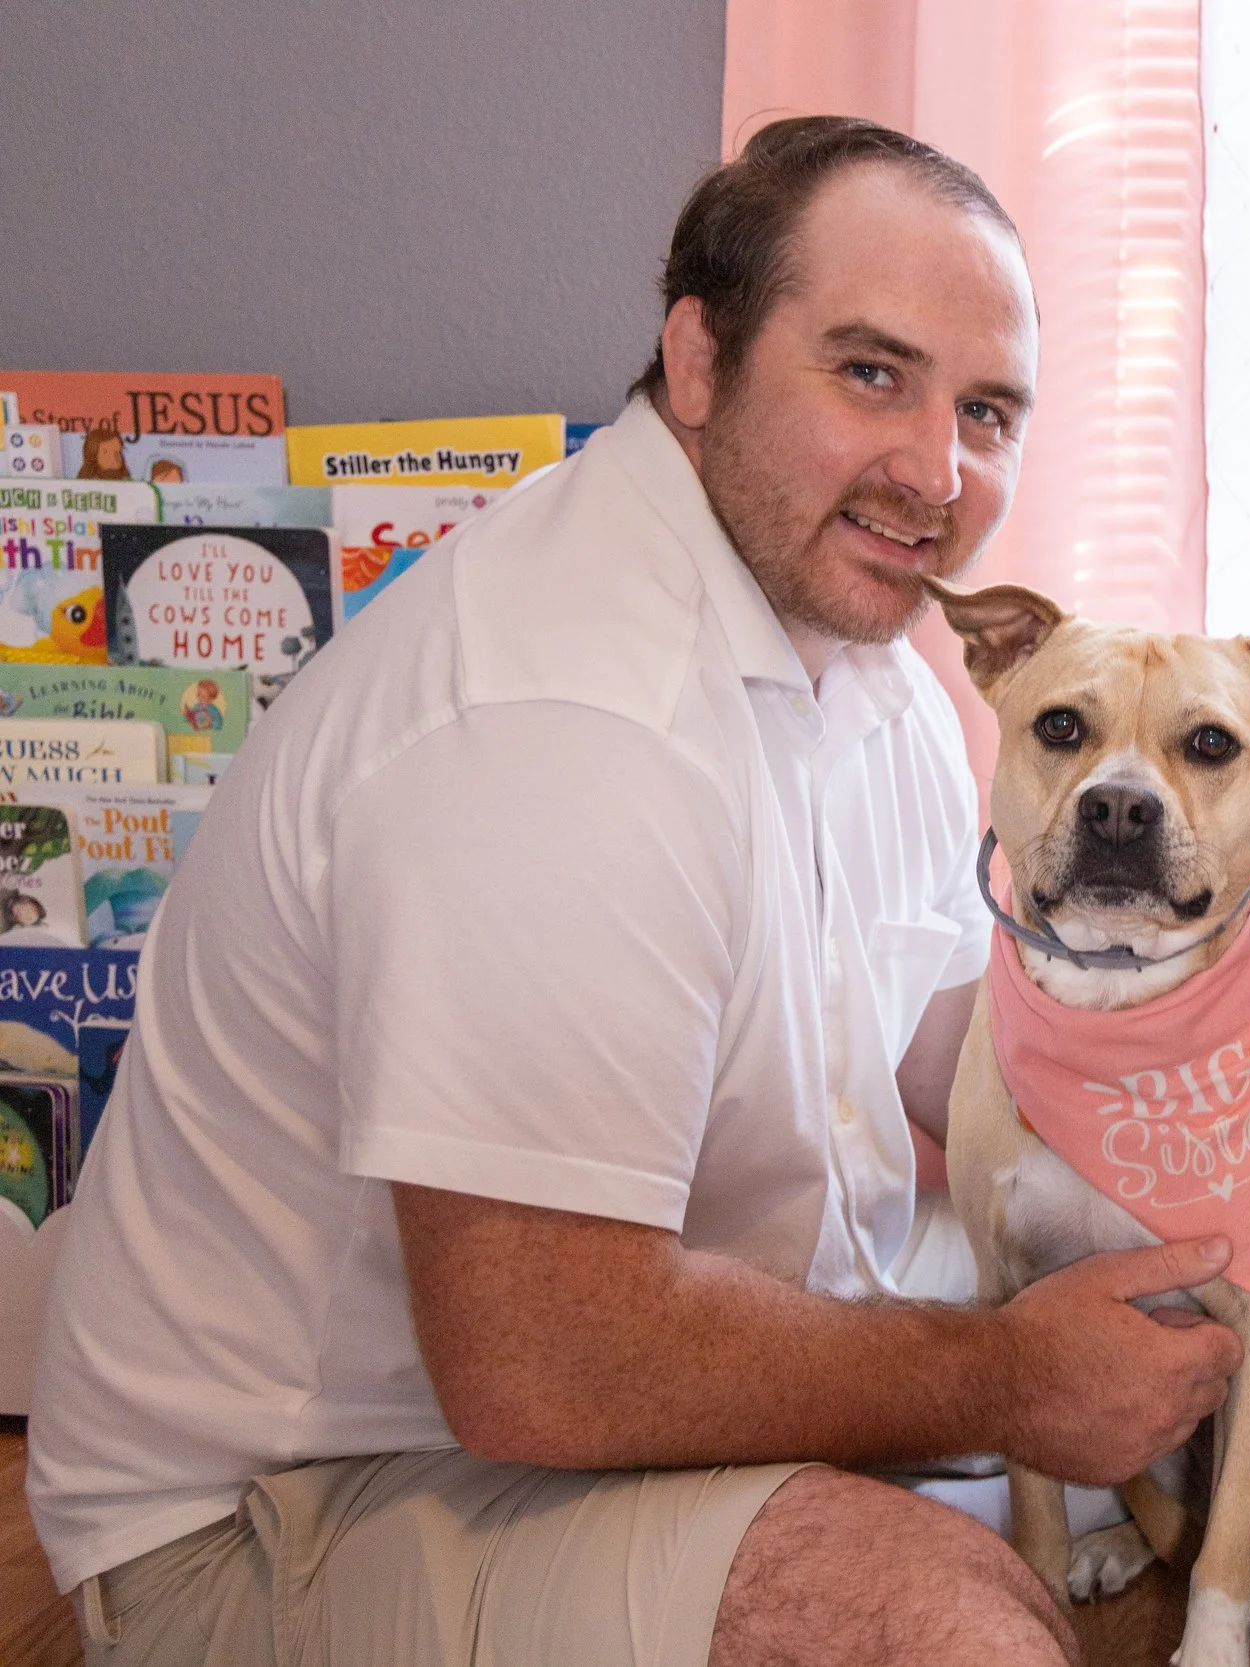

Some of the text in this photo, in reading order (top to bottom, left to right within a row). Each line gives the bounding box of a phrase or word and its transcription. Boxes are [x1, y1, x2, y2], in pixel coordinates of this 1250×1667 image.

[33, 408, 93, 432] Story
[99, 410, 121, 431] of
[124, 390, 274, 443] JESUS
[326, 449, 520, 476] Stiller the Hungry
[201, 542, 227, 558] I'LL
[159, 561, 274, 584] LOVE YOU
[184, 586, 249, 602] TILL THE
[148, 603, 286, 628] COWS COME
[173, 629, 265, 661] HOME
[0, 739, 80, 760] UESS
[103, 807, 173, 834] Pout
